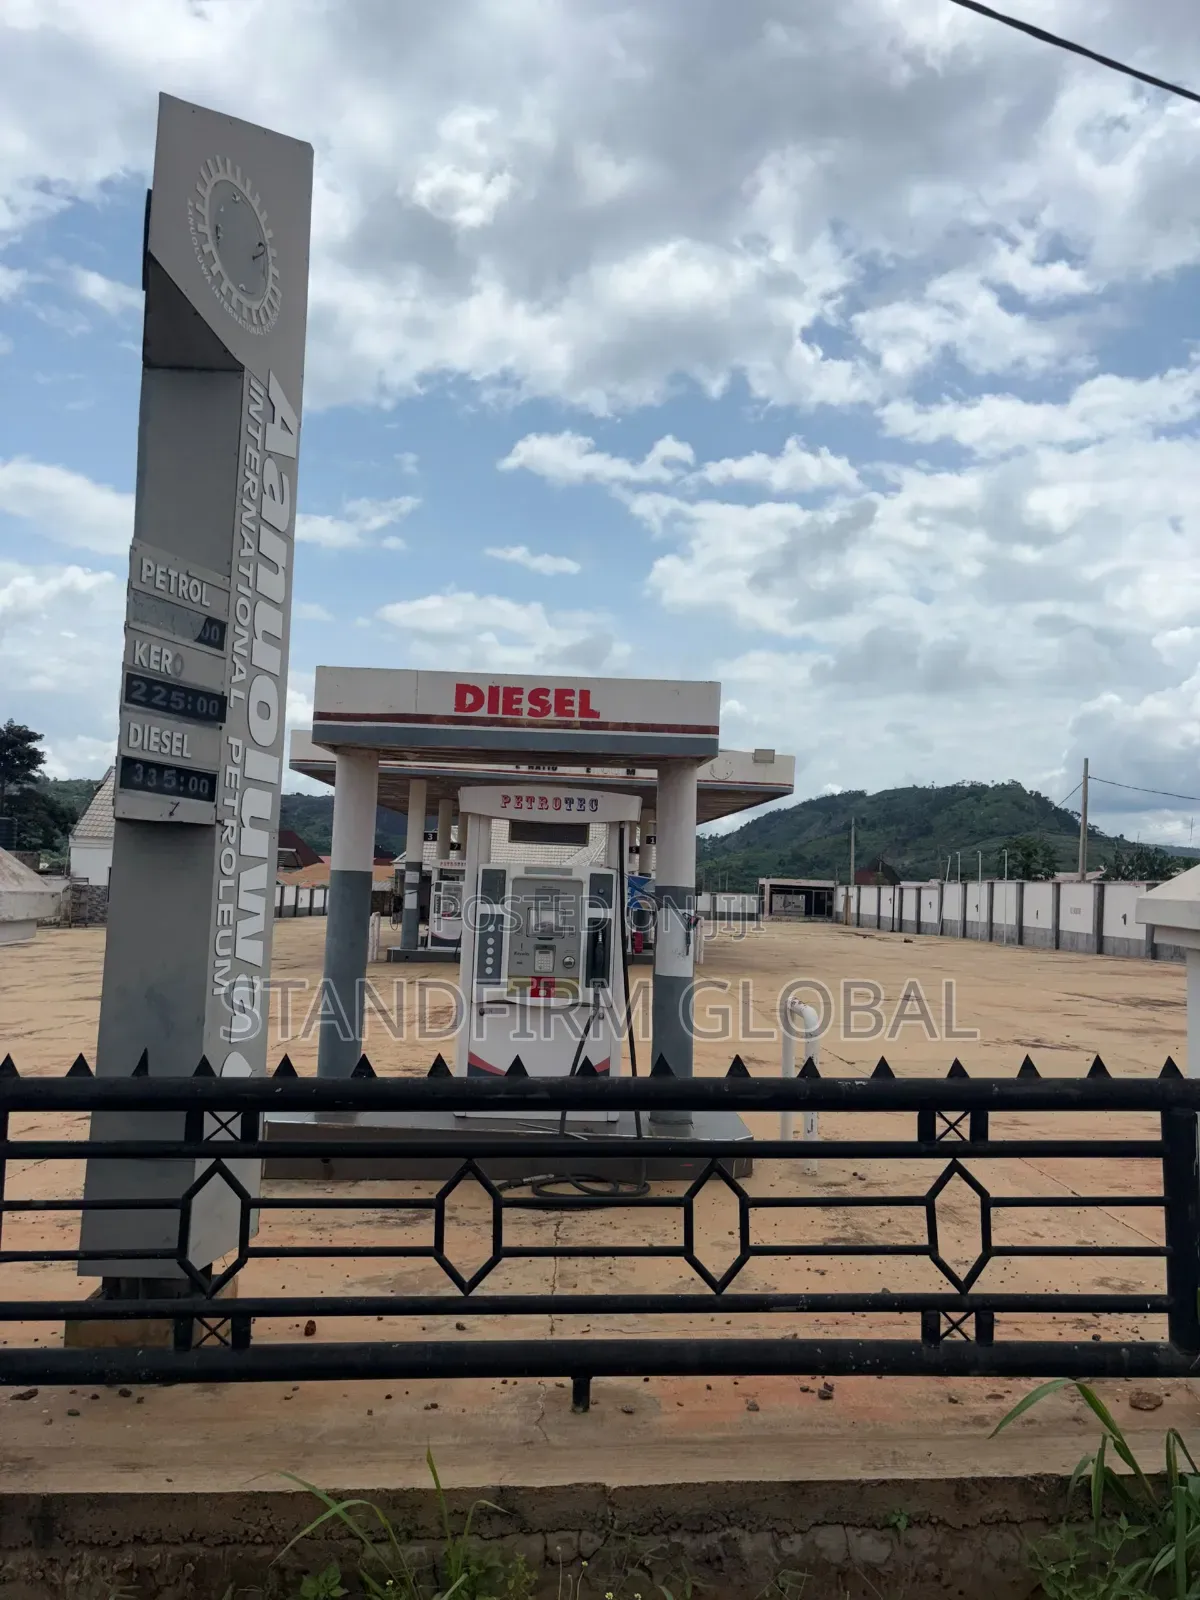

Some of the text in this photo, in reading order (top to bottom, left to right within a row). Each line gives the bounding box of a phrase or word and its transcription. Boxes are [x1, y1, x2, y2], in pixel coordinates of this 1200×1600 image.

[140, 557, 211, 608] PETROL
[129, 679, 220, 716] 225:00
[211, 377, 266, 997] INTERNATIONAL PETROLEUM
[454, 683, 601, 719] DIESEL
[128, 722, 192, 759] DIESEL
[132, 763, 210, 795] 335:00
[500, 794, 599, 812] PETROTEC
